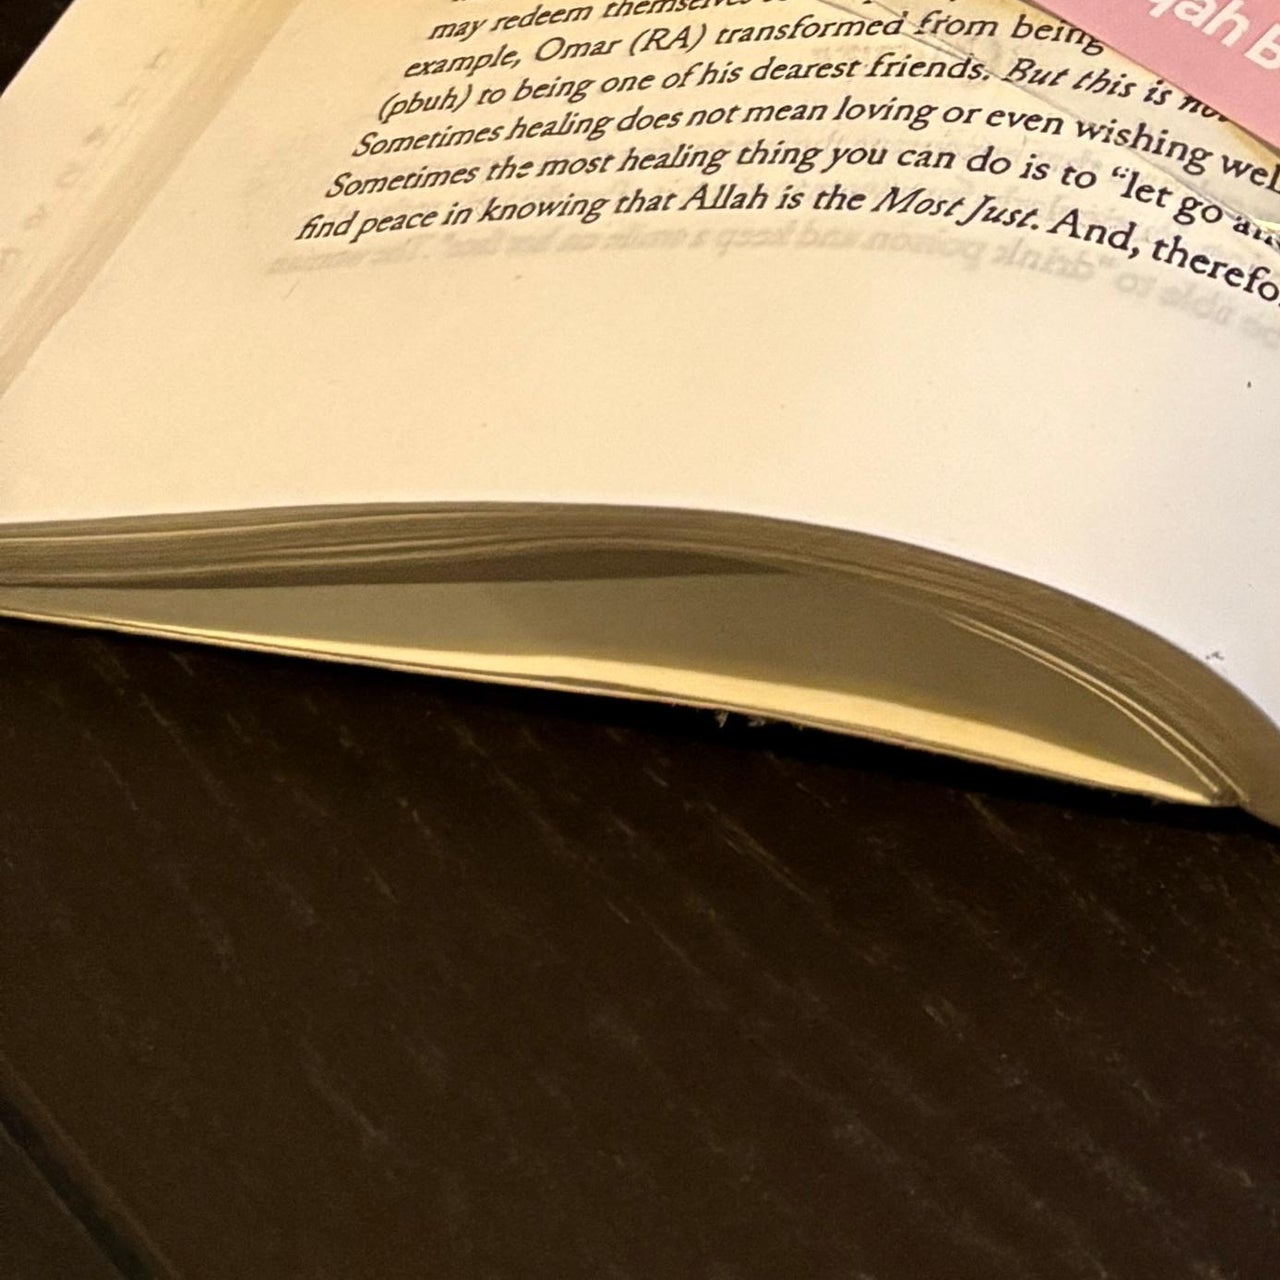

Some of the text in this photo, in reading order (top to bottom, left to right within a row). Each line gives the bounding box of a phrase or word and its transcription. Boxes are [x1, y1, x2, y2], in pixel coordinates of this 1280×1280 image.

[351, 124, 505, 158] Sometimes
[503, 111, 616, 142] healing
[616, 105, 684, 132] does
[685, 104, 742, 127] not
[741, 104, 829, 124] mean
[831, 94, 940, 132] loving
[941, 106, 983, 124] or
[985, 109, 1065, 136] even
[1075, 118, 1214, 176] wishing
[296, 209, 361, 241] find
[348, 210, 439, 244] peace
[440, 201, 474, 226] in
[476, 196, 611, 225] knowing
[613, 188, 678, 215] that
[677, 182, 769, 211] Allah
[774, 184, 805, 210] is
[812, 183, 867, 211] the
[867, 184, 962, 221] Most
[954, 192, 1041, 233] Just.
[1045, 207, 1140, 260] And,
[324, 165, 481, 199] Sometimes
[485, 154, 535, 182] the
[535, 154, 616, 178] most
[615, 142, 732, 175] healing
[736, 138, 825, 174] thing
[823, 147, 889, 174] you
[896, 149, 957, 170] can
[966, 144, 1012, 175] do
[1018, 153, 1051, 181] is
[1060, 165, 1098, 190] to
[1111, 165, 1175, 219] “let
[1173, 193, 1229, 225] go
